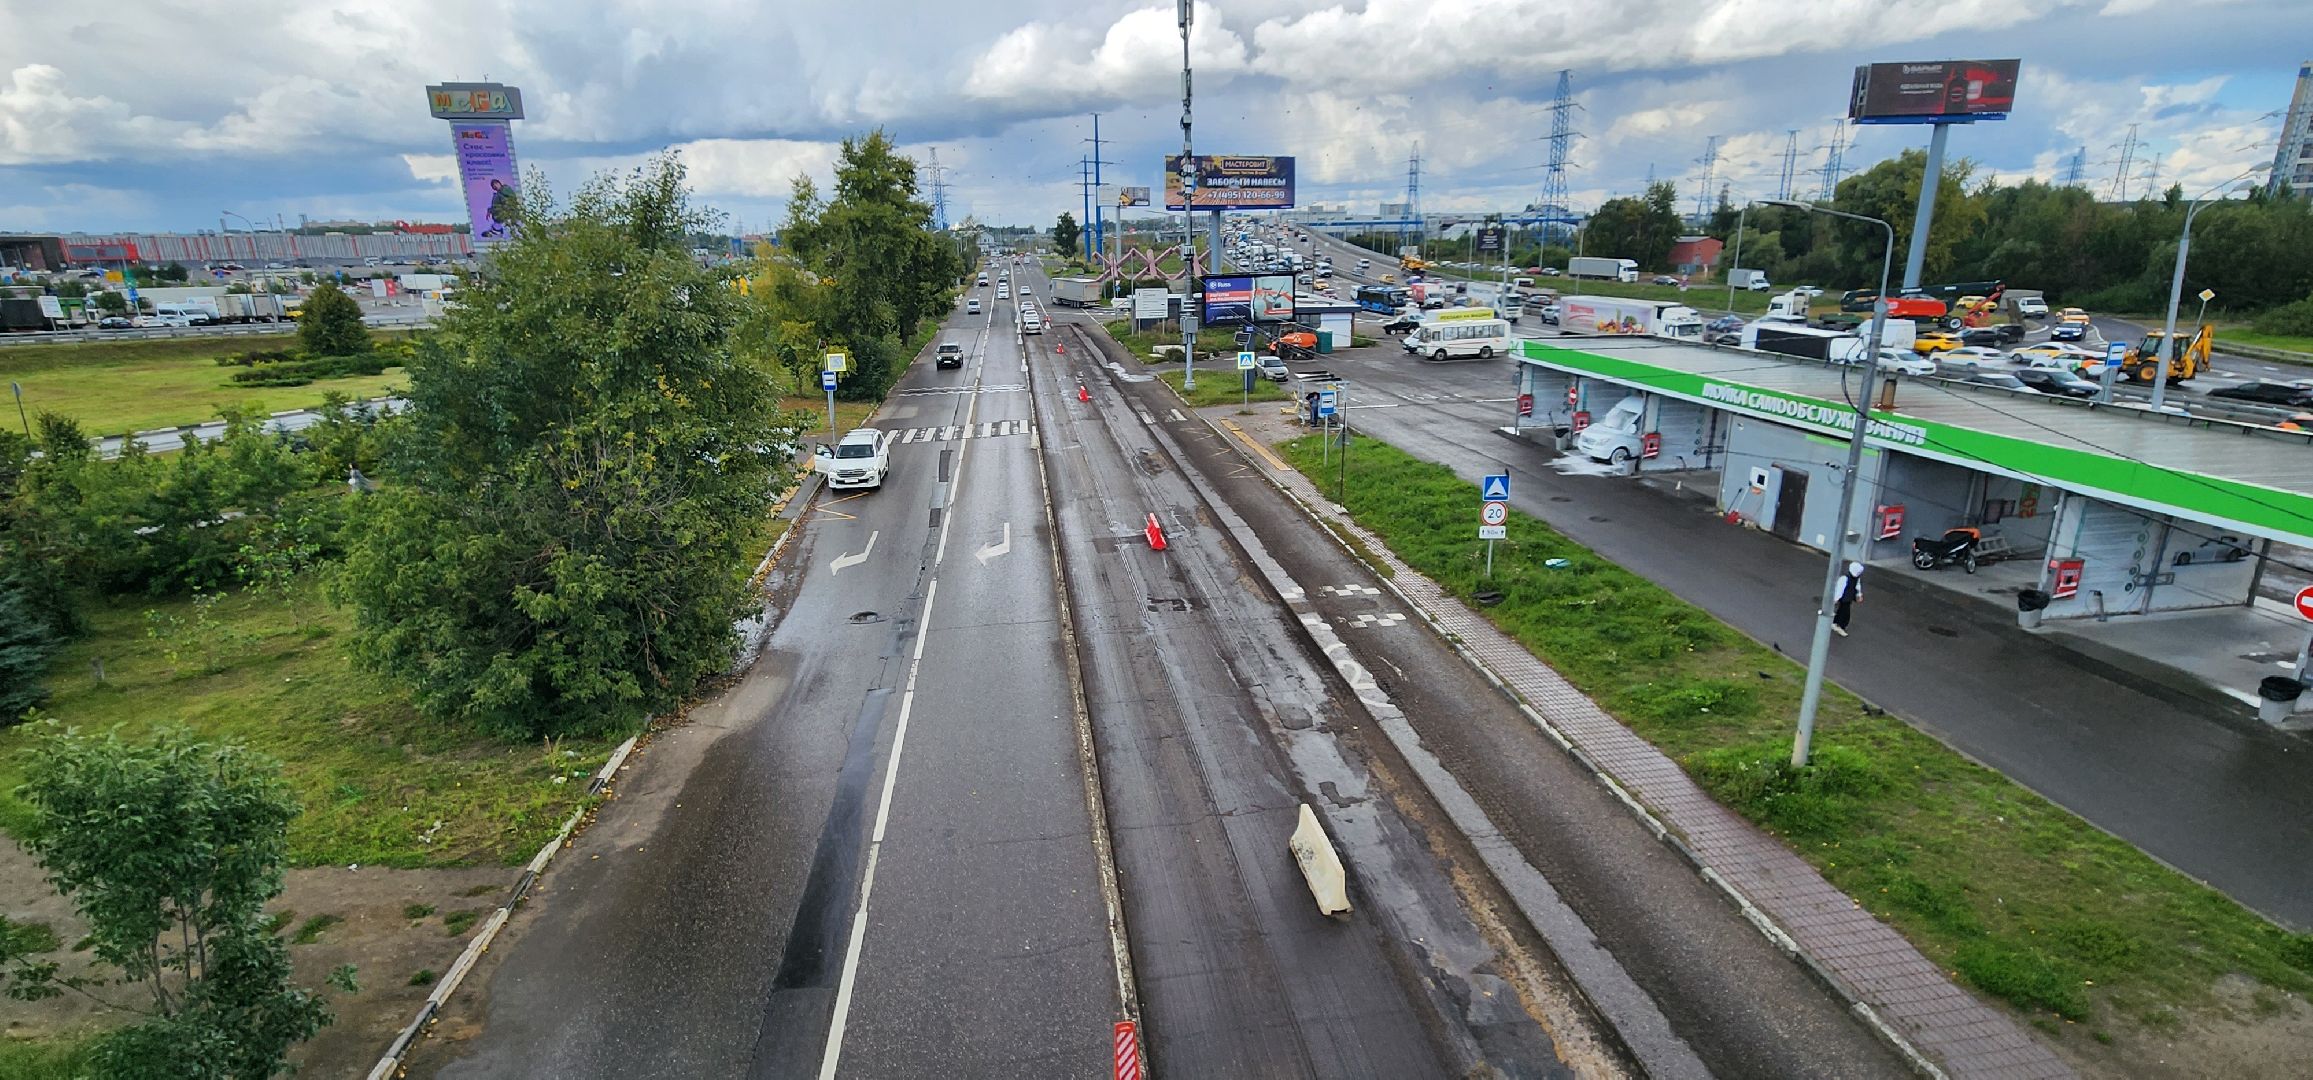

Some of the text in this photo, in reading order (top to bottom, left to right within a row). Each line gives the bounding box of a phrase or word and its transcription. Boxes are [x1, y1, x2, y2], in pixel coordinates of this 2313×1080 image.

[1207, 178, 1242, 186] ЗАБОРЫ
[1251, 178, 1286, 186] НАВЕСЫ
[1219, 191, 1241, 199] (495)
[1702, 382, 1927, 446] МОЙКА САМООБСЛУЖВАНИЯ
[1488, 509, 1502, 518] 20
